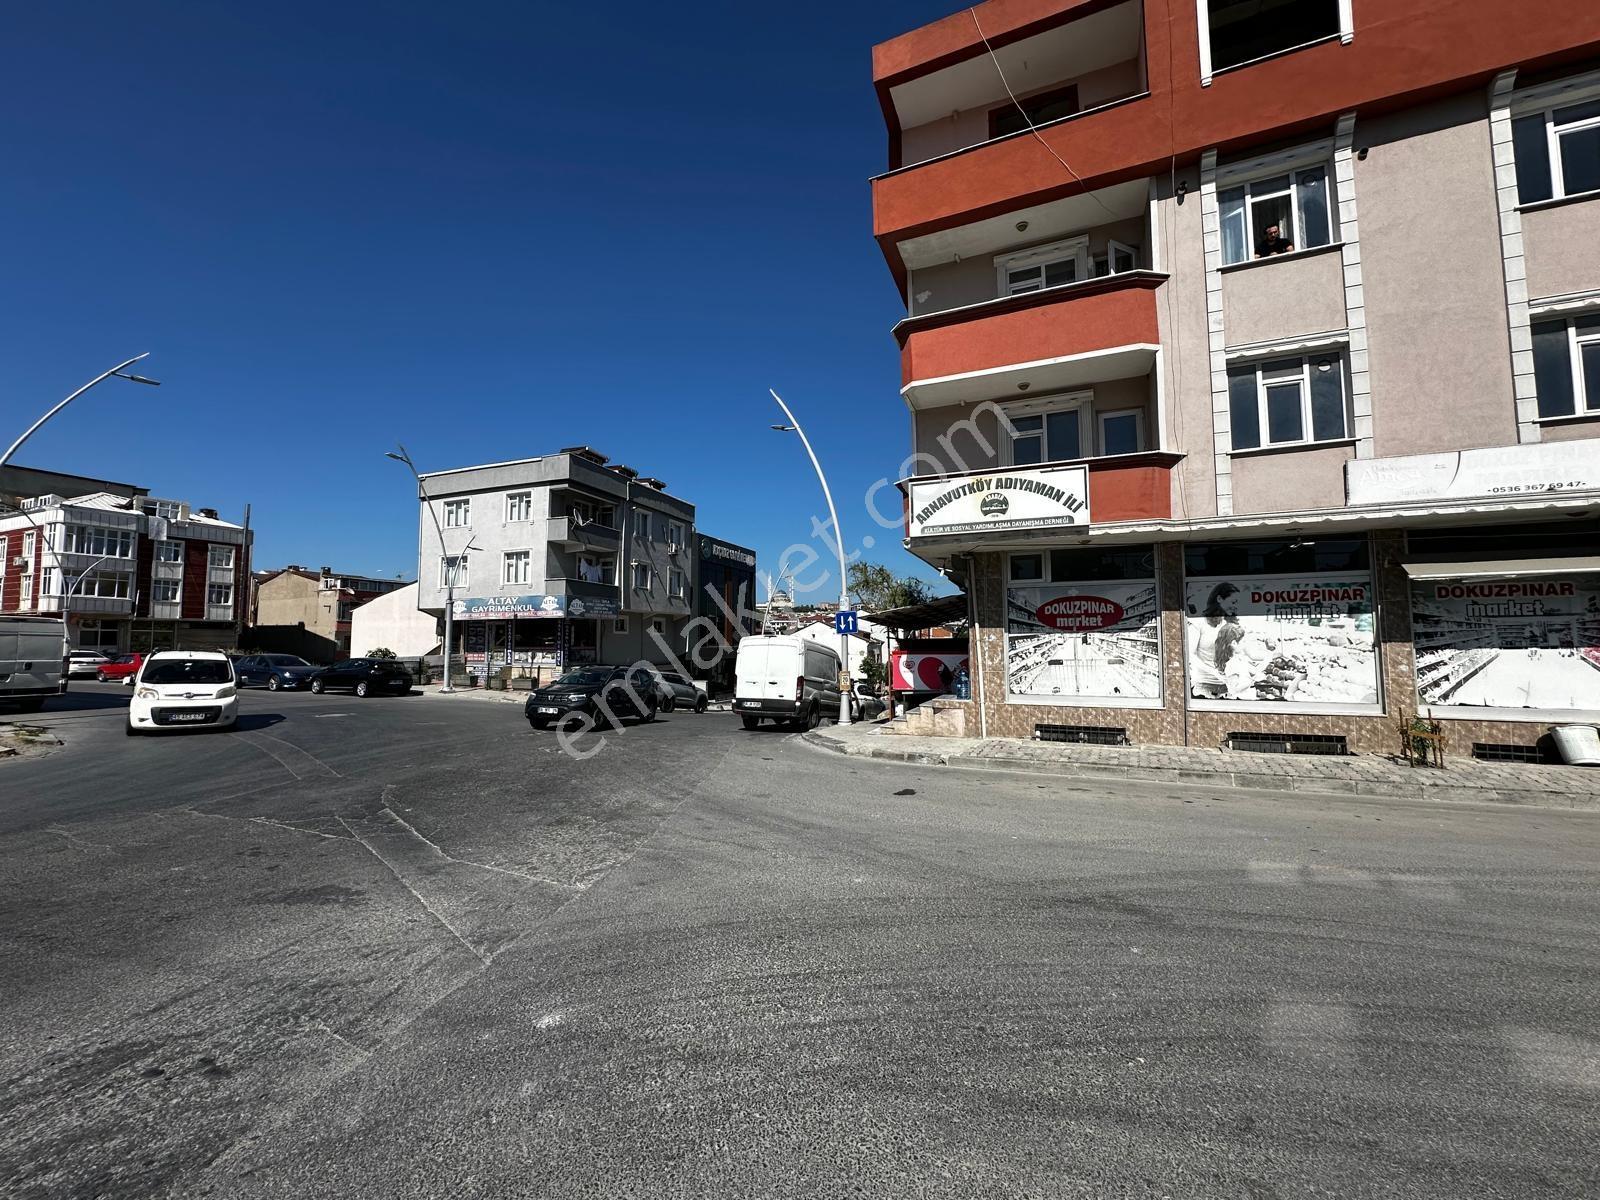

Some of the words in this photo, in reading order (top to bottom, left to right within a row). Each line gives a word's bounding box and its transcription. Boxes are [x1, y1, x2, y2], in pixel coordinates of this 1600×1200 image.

[915, 477, 993, 525] ARNAVUTKÖY
[994, 477, 1065, 503] ADIYAMAN
[1062, 493, 1085, 514] İLİ
[951, 524, 971, 532] SOSYAL
[1250, 588, 1365, 604] DOKUZPINAR
[1436, 582, 1575, 599] DOKUZPINAR
[487, 596, 519, 605] ALTAY
[1044, 600, 1115, 615] DOKUZPINAR
[1466, 600, 1545, 617] market
[1275, 604, 1341, 620] market
[1056, 614, 1103, 627] market
